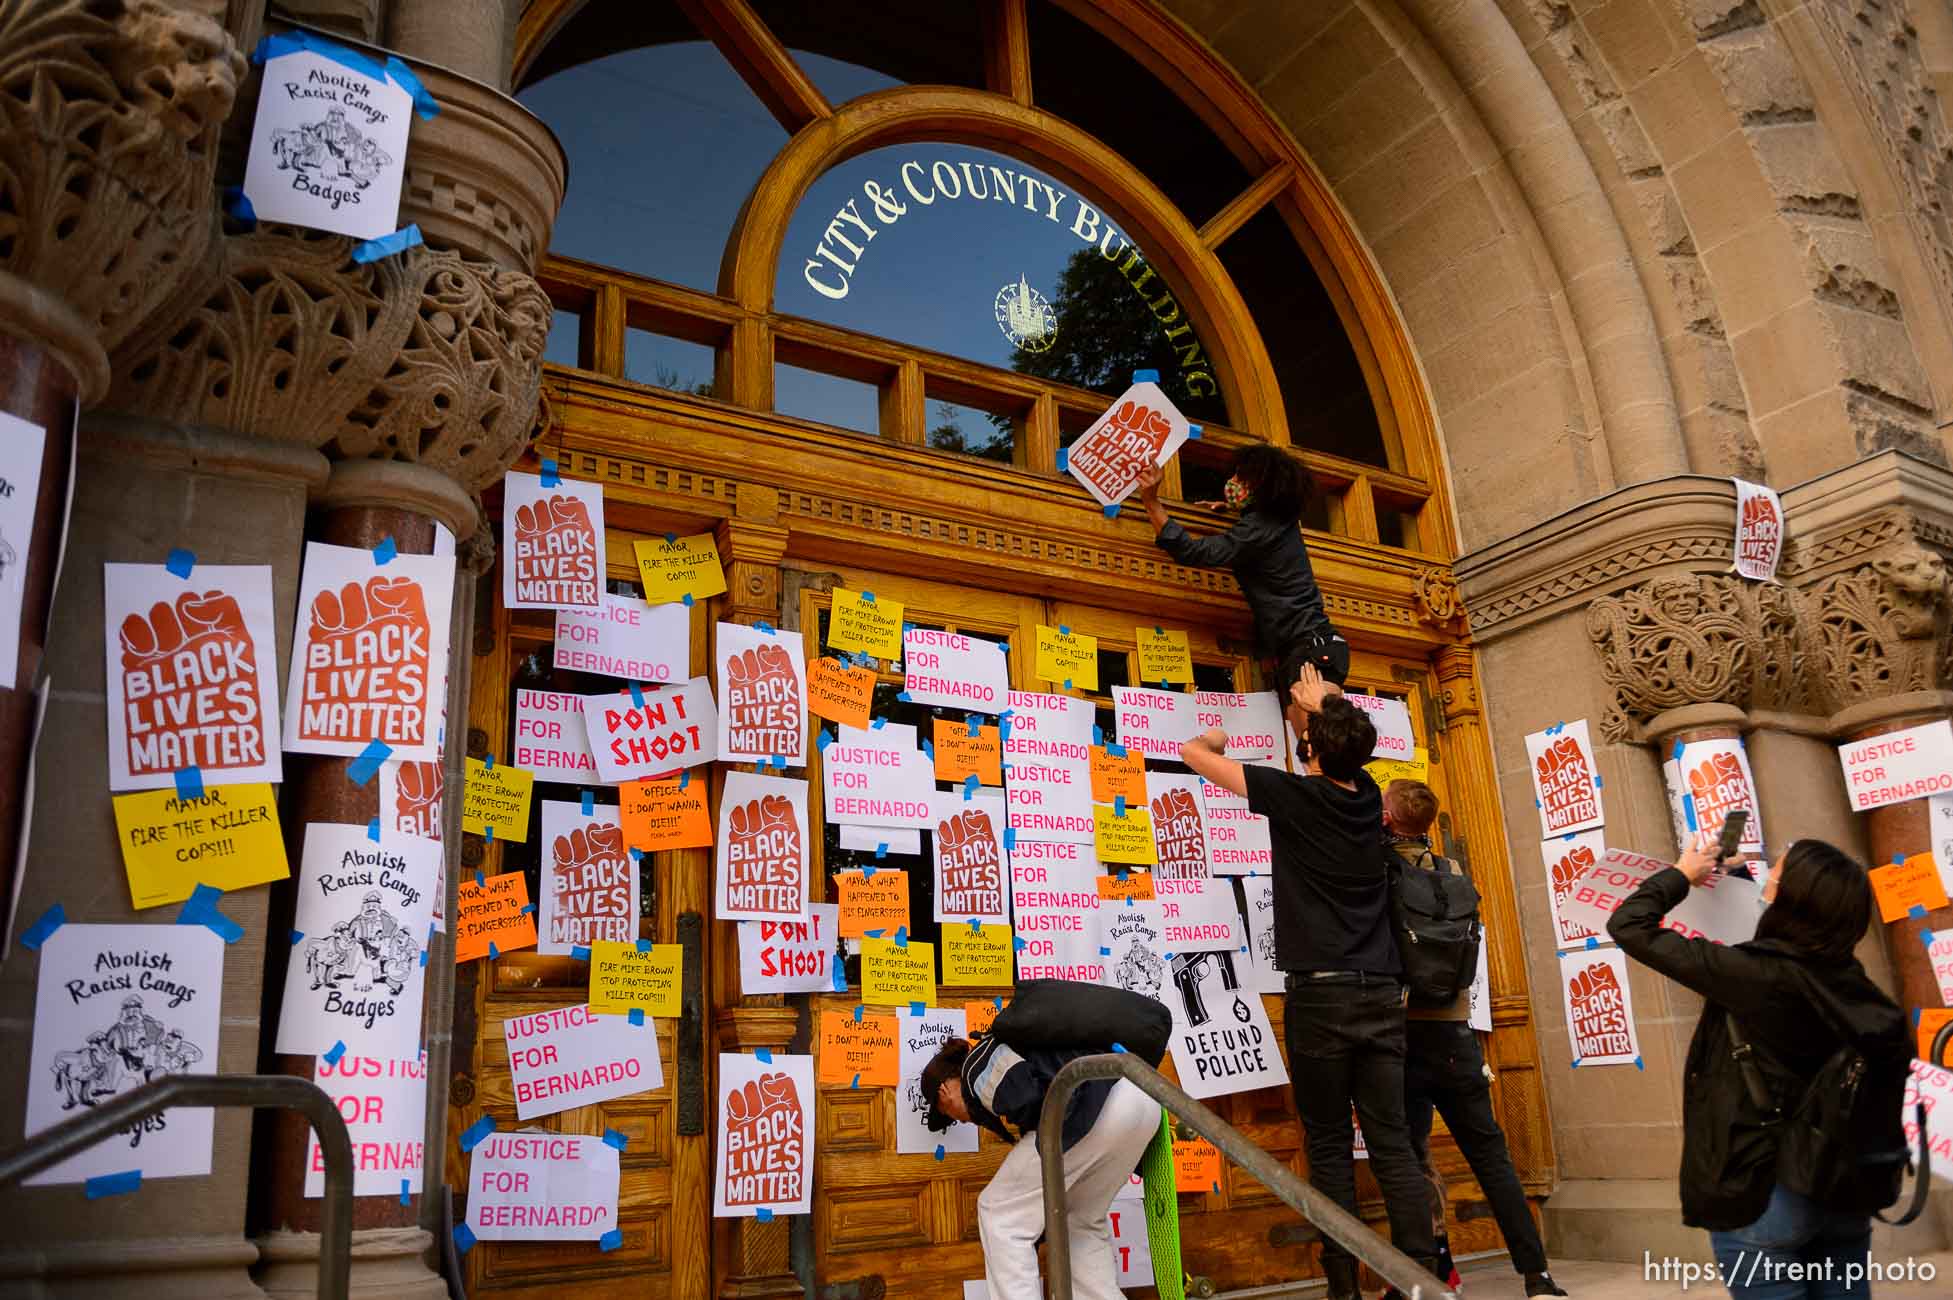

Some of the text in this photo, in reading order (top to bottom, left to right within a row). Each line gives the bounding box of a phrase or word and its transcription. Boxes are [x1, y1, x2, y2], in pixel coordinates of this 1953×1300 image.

[284, 82, 338, 101] Racist
[308, 69, 371, 98] Abolish
[292, 174, 361, 210] Badges
[804, 160, 1217, 398] CITY & COUNTY BUILDING
[1100, 424, 1158, 467] BLACK
[1087, 435, 1141, 482] LIVES
[1072, 447, 1125, 498] MATTER
[1743, 520, 1777, 540] BLACK
[517, 529, 594, 558] BLACK
[1740, 542, 1775, 562] LIVES
[518, 555, 595, 581] LIVES
[643, 552, 715, 570] FIRE THE KILLER
[517, 580, 596, 604] MATTER
[838, 605, 896, 626] FIRE BROWN
[557, 624, 598, 644] FOR
[841, 630, 861, 642] KILLER
[854, 621, 894, 637] PROTECTING
[309, 624, 429, 668] BLACK
[905, 631, 970, 651] JUSTICE
[127, 640, 255, 701] BLACK
[556, 650, 670, 681] BERNARDO
[907, 651, 939, 669] FOR
[306, 664, 423, 703] LIVES
[730, 678, 798, 705] BLACK
[815, 671, 863, 697] HAPPENED TO
[906, 674, 994, 701] BERNARDO
[128, 681, 257, 735] LIVES
[1007, 692, 1068, 711] JUSTICE
[1121, 692, 1175, 711] JUSTICE
[1196, 693, 1248, 708] JUSTICE
[303, 703, 422, 741] MATTER
[730, 703, 798, 728] LIVES
[1122, 713, 1149, 729] FOR
[1198, 712, 1223, 727] FOR
[518, 719, 561, 739] FOR
[730, 727, 798, 754] MATTER
[131, 725, 264, 771] MATTER
[610, 725, 701, 766] SHOOT
[832, 747, 901, 767] JUSTICE
[968, 743, 995, 752] WANNA
[1006, 738, 1088, 760] BERNARDO
[1848, 737, 1915, 765] JUSTICE
[833, 772, 867, 788] FOR
[1008, 766, 1072, 784] JUSTICE
[1542, 758, 1588, 793] BLACK
[1851, 768, 1887, 785] FOR
[472, 781, 493, 793] MIKE
[495, 786, 524, 799] BROWN
[1010, 790, 1042, 805] FOR
[1545, 783, 1592, 808] LIVES
[1696, 778, 1749, 812] BLACK
[1858, 774, 1952, 807] BERNARDO
[472, 795, 521, 813] PROTECTING
[667, 799, 702, 811] WANNA
[835, 797, 929, 818] BERNARDO
[1548, 801, 1597, 829] MATTER
[130, 806, 271, 848] FIRE THE KILLER
[1011, 814, 1094, 832] BERNARDO
[1157, 814, 1201, 841] BLACK
[1210, 827, 1236, 841] FOR
[176, 839, 236, 863] COPS!!!
[729, 829, 799, 861] BLACK
[942, 840, 998, 868] BLACK
[1012, 843, 1077, 860] JUSTICE
[1158, 838, 1204, 861] LIVES
[342, 850, 406, 873] Abolish
[729, 857, 799, 885] LIVES
[1159, 859, 1208, 879] MATTER
[318, 872, 374, 896] Racist
[488, 878, 516, 893] WHAT
[556, 859, 629, 892] BLACK
[876, 876, 900, 887] WHAT
[943, 864, 999, 890] LIVES
[1014, 867, 1047, 883] FOR
[729, 882, 799, 911] MATTER
[848, 892, 900, 902] HAPPENED TO
[1155, 879, 1204, 895] USTICE
[504, 897, 518, 908] TO
[553, 887, 628, 916] LIVES
[944, 889, 1000, 912] MATTER
[1016, 892, 1100, 909] BERNARDO
[552, 915, 628, 943] MATTER
[1018, 915, 1083, 931] JUSTICE
[1118, 912, 1146, 924] Abolish
[1165, 924, 1230, 942] ERNARDO
[1019, 941, 1054, 956] FOR
[95, 951, 173, 973] Abolish
[600, 963, 674, 975] FIRE MIKE BROWN
[761, 946, 825, 977] SHOOT
[904, 961, 929, 969] BROWN
[601, 976, 672, 988] STOP PROTECTING
[874, 983, 898, 992] KILLER
[887, 972, 928, 982] PROTECTING
[65, 974, 132, 1004] Racist
[605, 990, 634, 1000] KILLER
[324, 993, 395, 1029] Badges
[1572, 988, 1622, 1022] BLACK
[507, 1007, 599, 1040] JUSTICE
[920, 1023, 955, 1036] Abolish
[1574, 1010, 1625, 1038] LIVES
[862, 1037, 894, 1048] WANNA
[908, 1035, 938, 1053] Racist
[1184, 1025, 1263, 1055] DEFUND
[1579, 1033, 1631, 1057] MATTER
[512, 1045, 558, 1071] FOR
[1195, 1048, 1268, 1081] POLICE
[516, 1058, 641, 1103] BERNARDO
[729, 1109, 801, 1151] BLACK
[484, 1139, 581, 1160] JUSTICE
[728, 1139, 800, 1176] LIVES
[481, 1172, 529, 1193] FOR
[727, 1170, 800, 1203] MATTER
